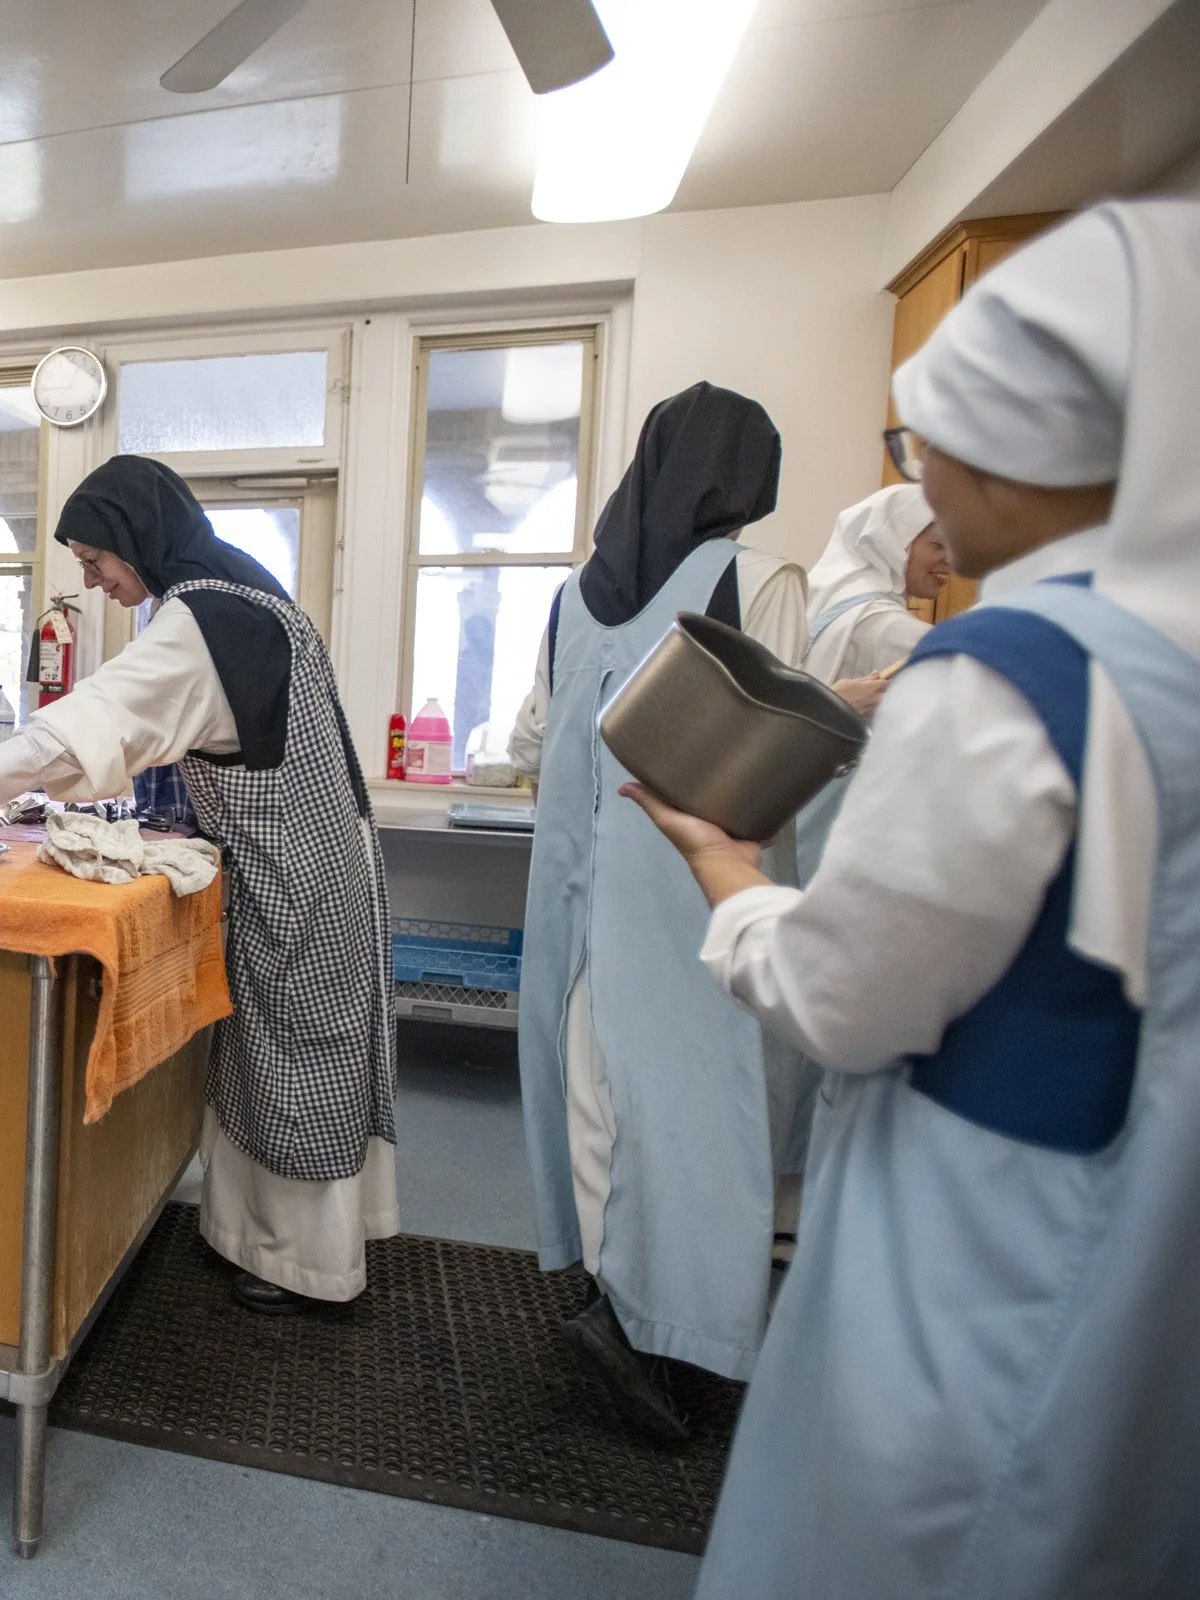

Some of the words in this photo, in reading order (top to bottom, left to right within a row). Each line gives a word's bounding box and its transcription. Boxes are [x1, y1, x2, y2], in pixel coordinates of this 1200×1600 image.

[53, 407, 59, 416] 7
[65, 410, 72, 420] 6
[80, 405, 87, 415] 5
